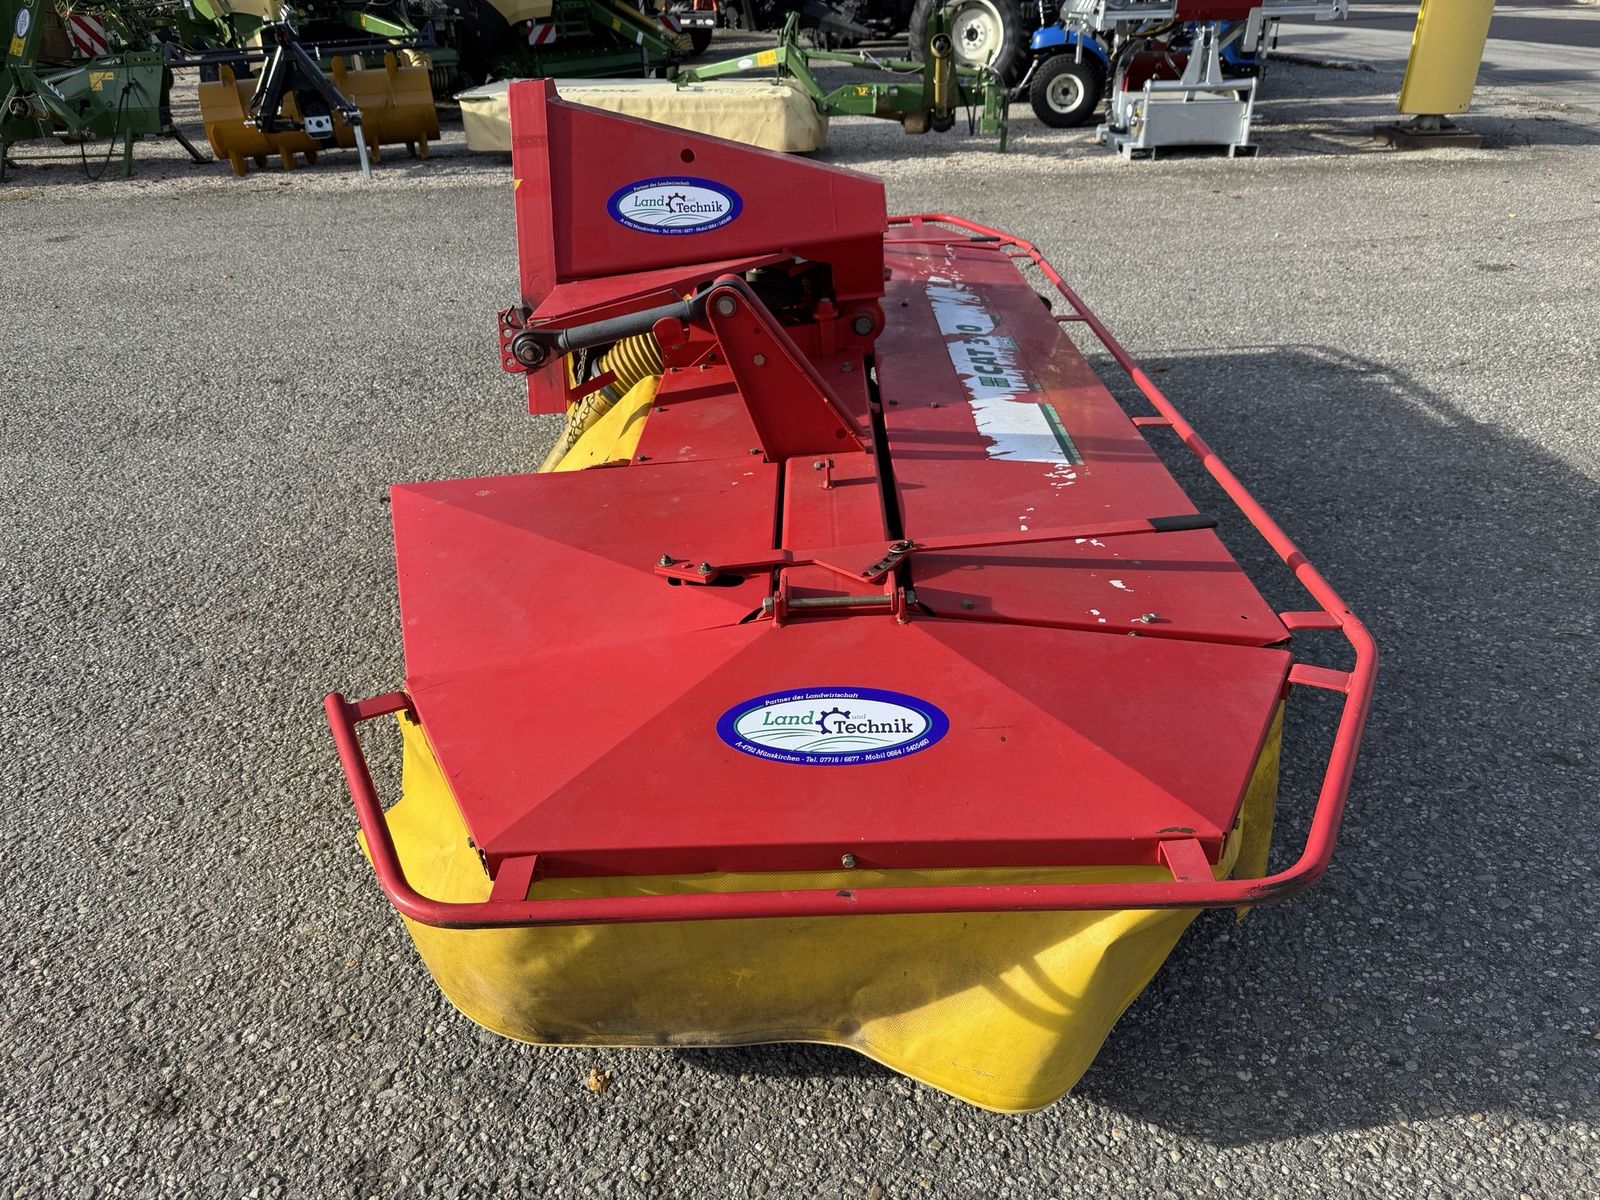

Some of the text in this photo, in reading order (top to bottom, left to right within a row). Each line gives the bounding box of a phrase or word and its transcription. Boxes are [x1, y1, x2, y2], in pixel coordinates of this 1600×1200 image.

[634, 195, 665, 207] Land
[676, 201, 723, 213] Technik
[967, 348, 1004, 376] CAT
[765, 696, 791, 706] Partner
[805, 692, 859, 700] Landwirtschaft
[762, 710, 814, 726] Land
[833, 718, 914, 734] Technik
[756, 749, 800, 763] Münzkirchen
[865, 752, 886, 761] Mobil
[886, 749, 902, 758] 0664
